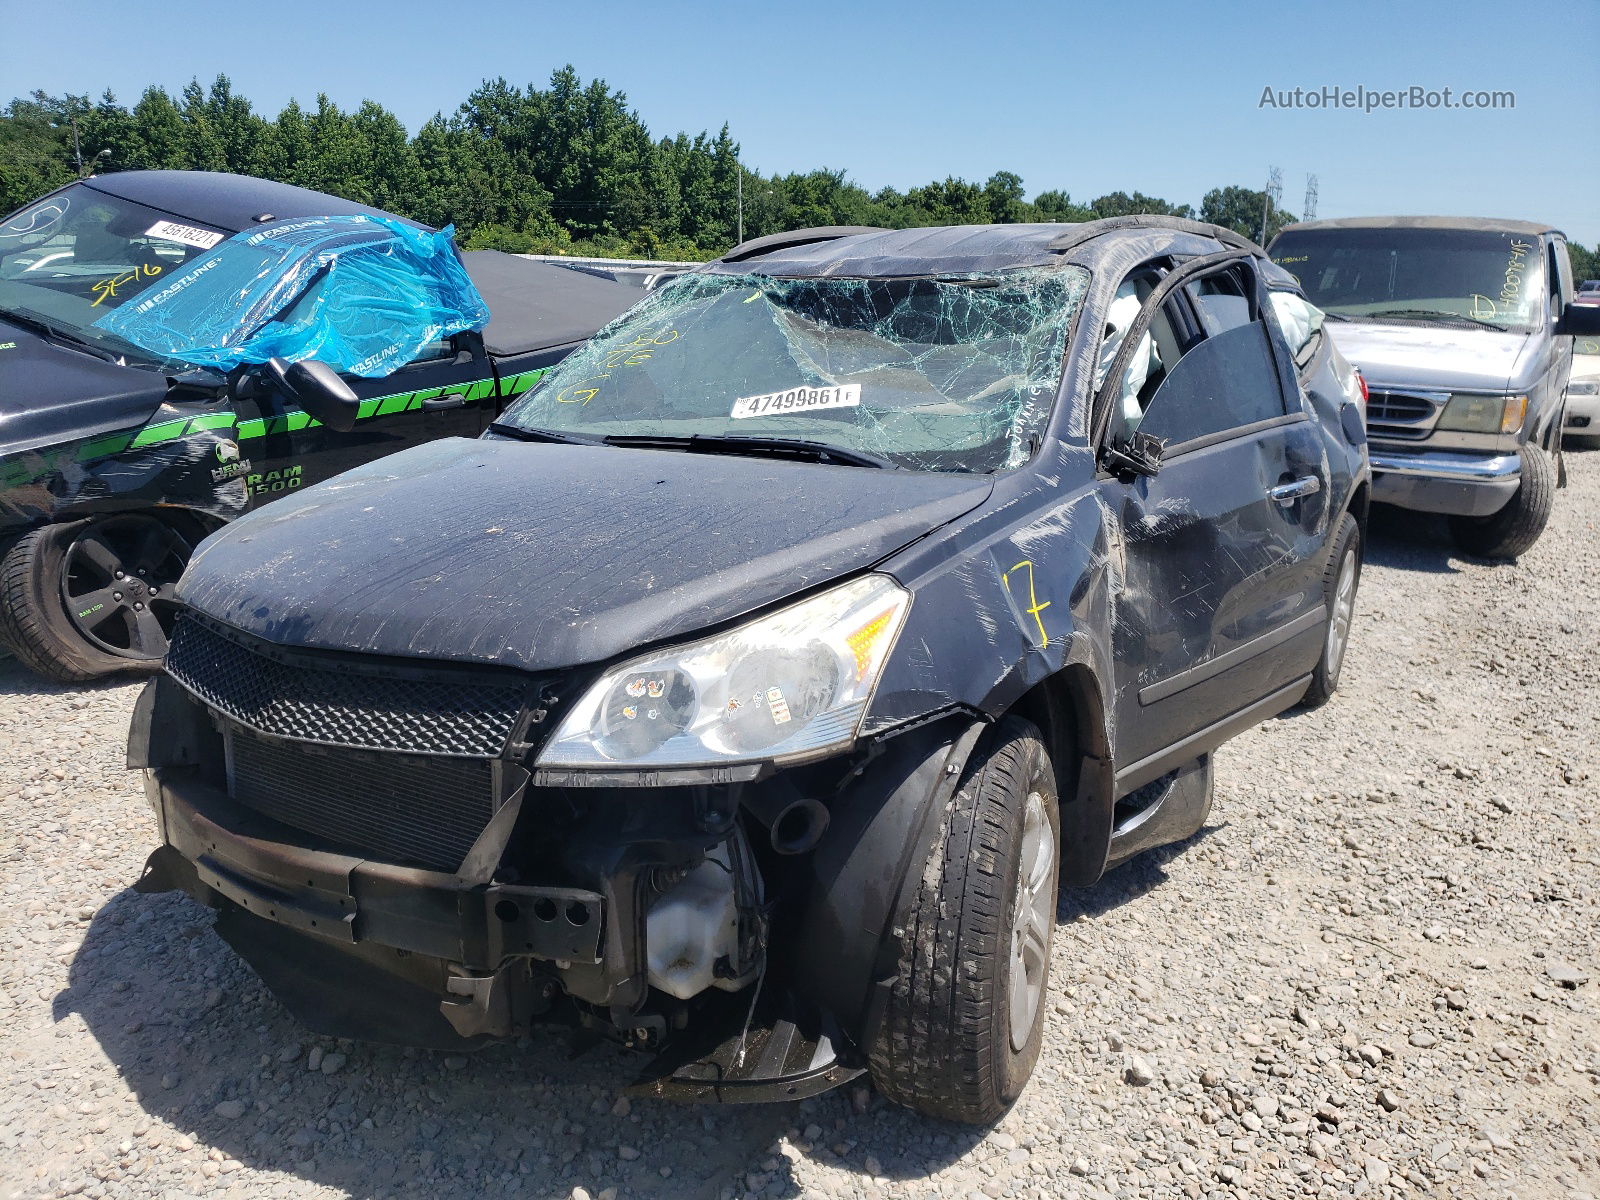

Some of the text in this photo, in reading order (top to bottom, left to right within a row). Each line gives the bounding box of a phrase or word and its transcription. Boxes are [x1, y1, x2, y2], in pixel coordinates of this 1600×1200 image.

[748, 388, 841, 413] 47499861
[247, 465, 302, 485] RAM
[247, 478, 301, 496] 1500
